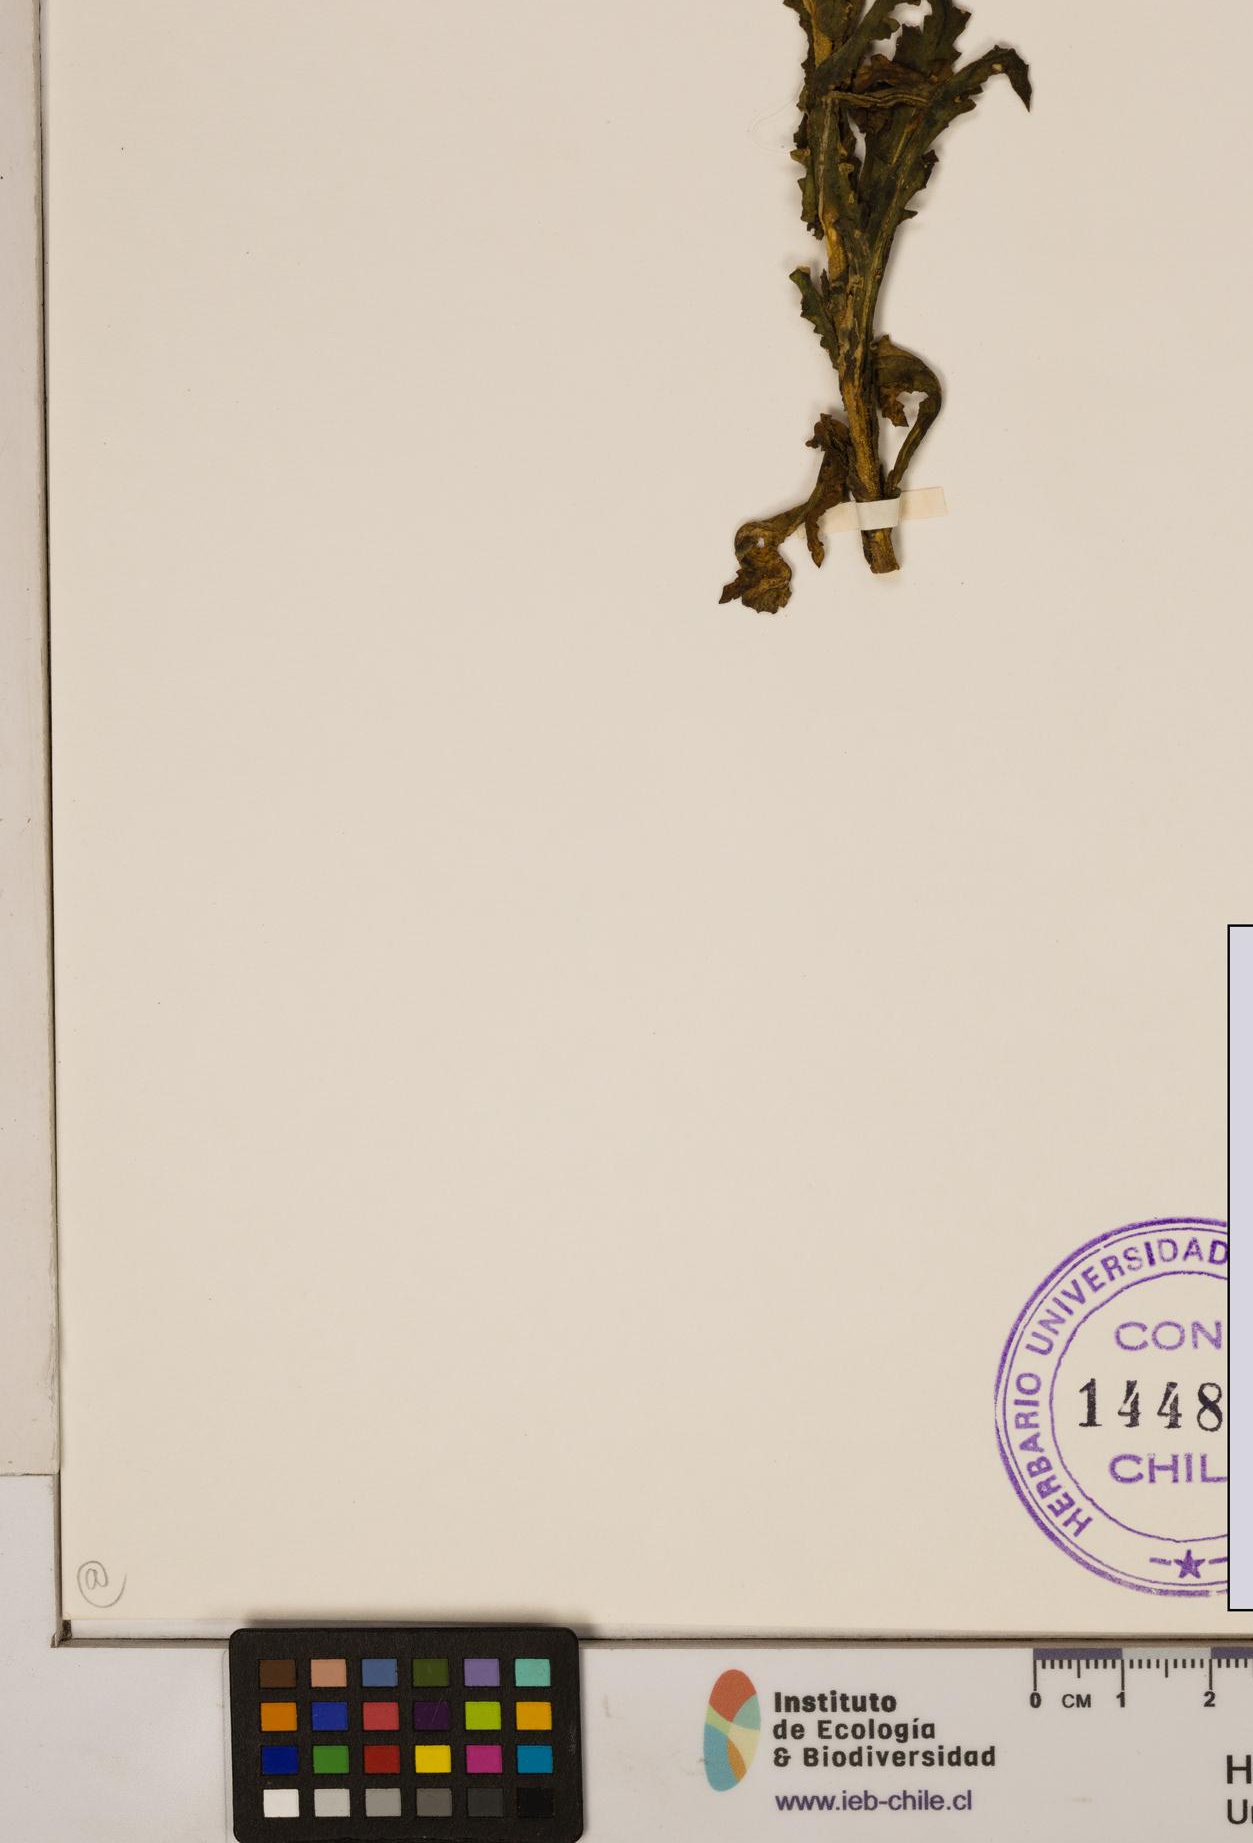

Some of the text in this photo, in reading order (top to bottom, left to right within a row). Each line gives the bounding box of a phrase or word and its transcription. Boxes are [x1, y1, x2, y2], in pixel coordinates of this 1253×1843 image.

[1013, 1238, 1228, 1537] HERBARIO UNIVERSIDAD
[774, 1689, 897, 1713] Instituto
[1029, 1691, 1042, 1709] 0
[1061, 1693, 1092, 1709] CM
[1116, 1689, 1126, 1708] 1
[1203, 1688, 1216, 1708] 2
[772, 1717, 936, 1744] de Ecología
[773, 1744, 996, 1768] & Biodiversidad
[774, 1789, 972, 1811] www.ieb-chile.cl
